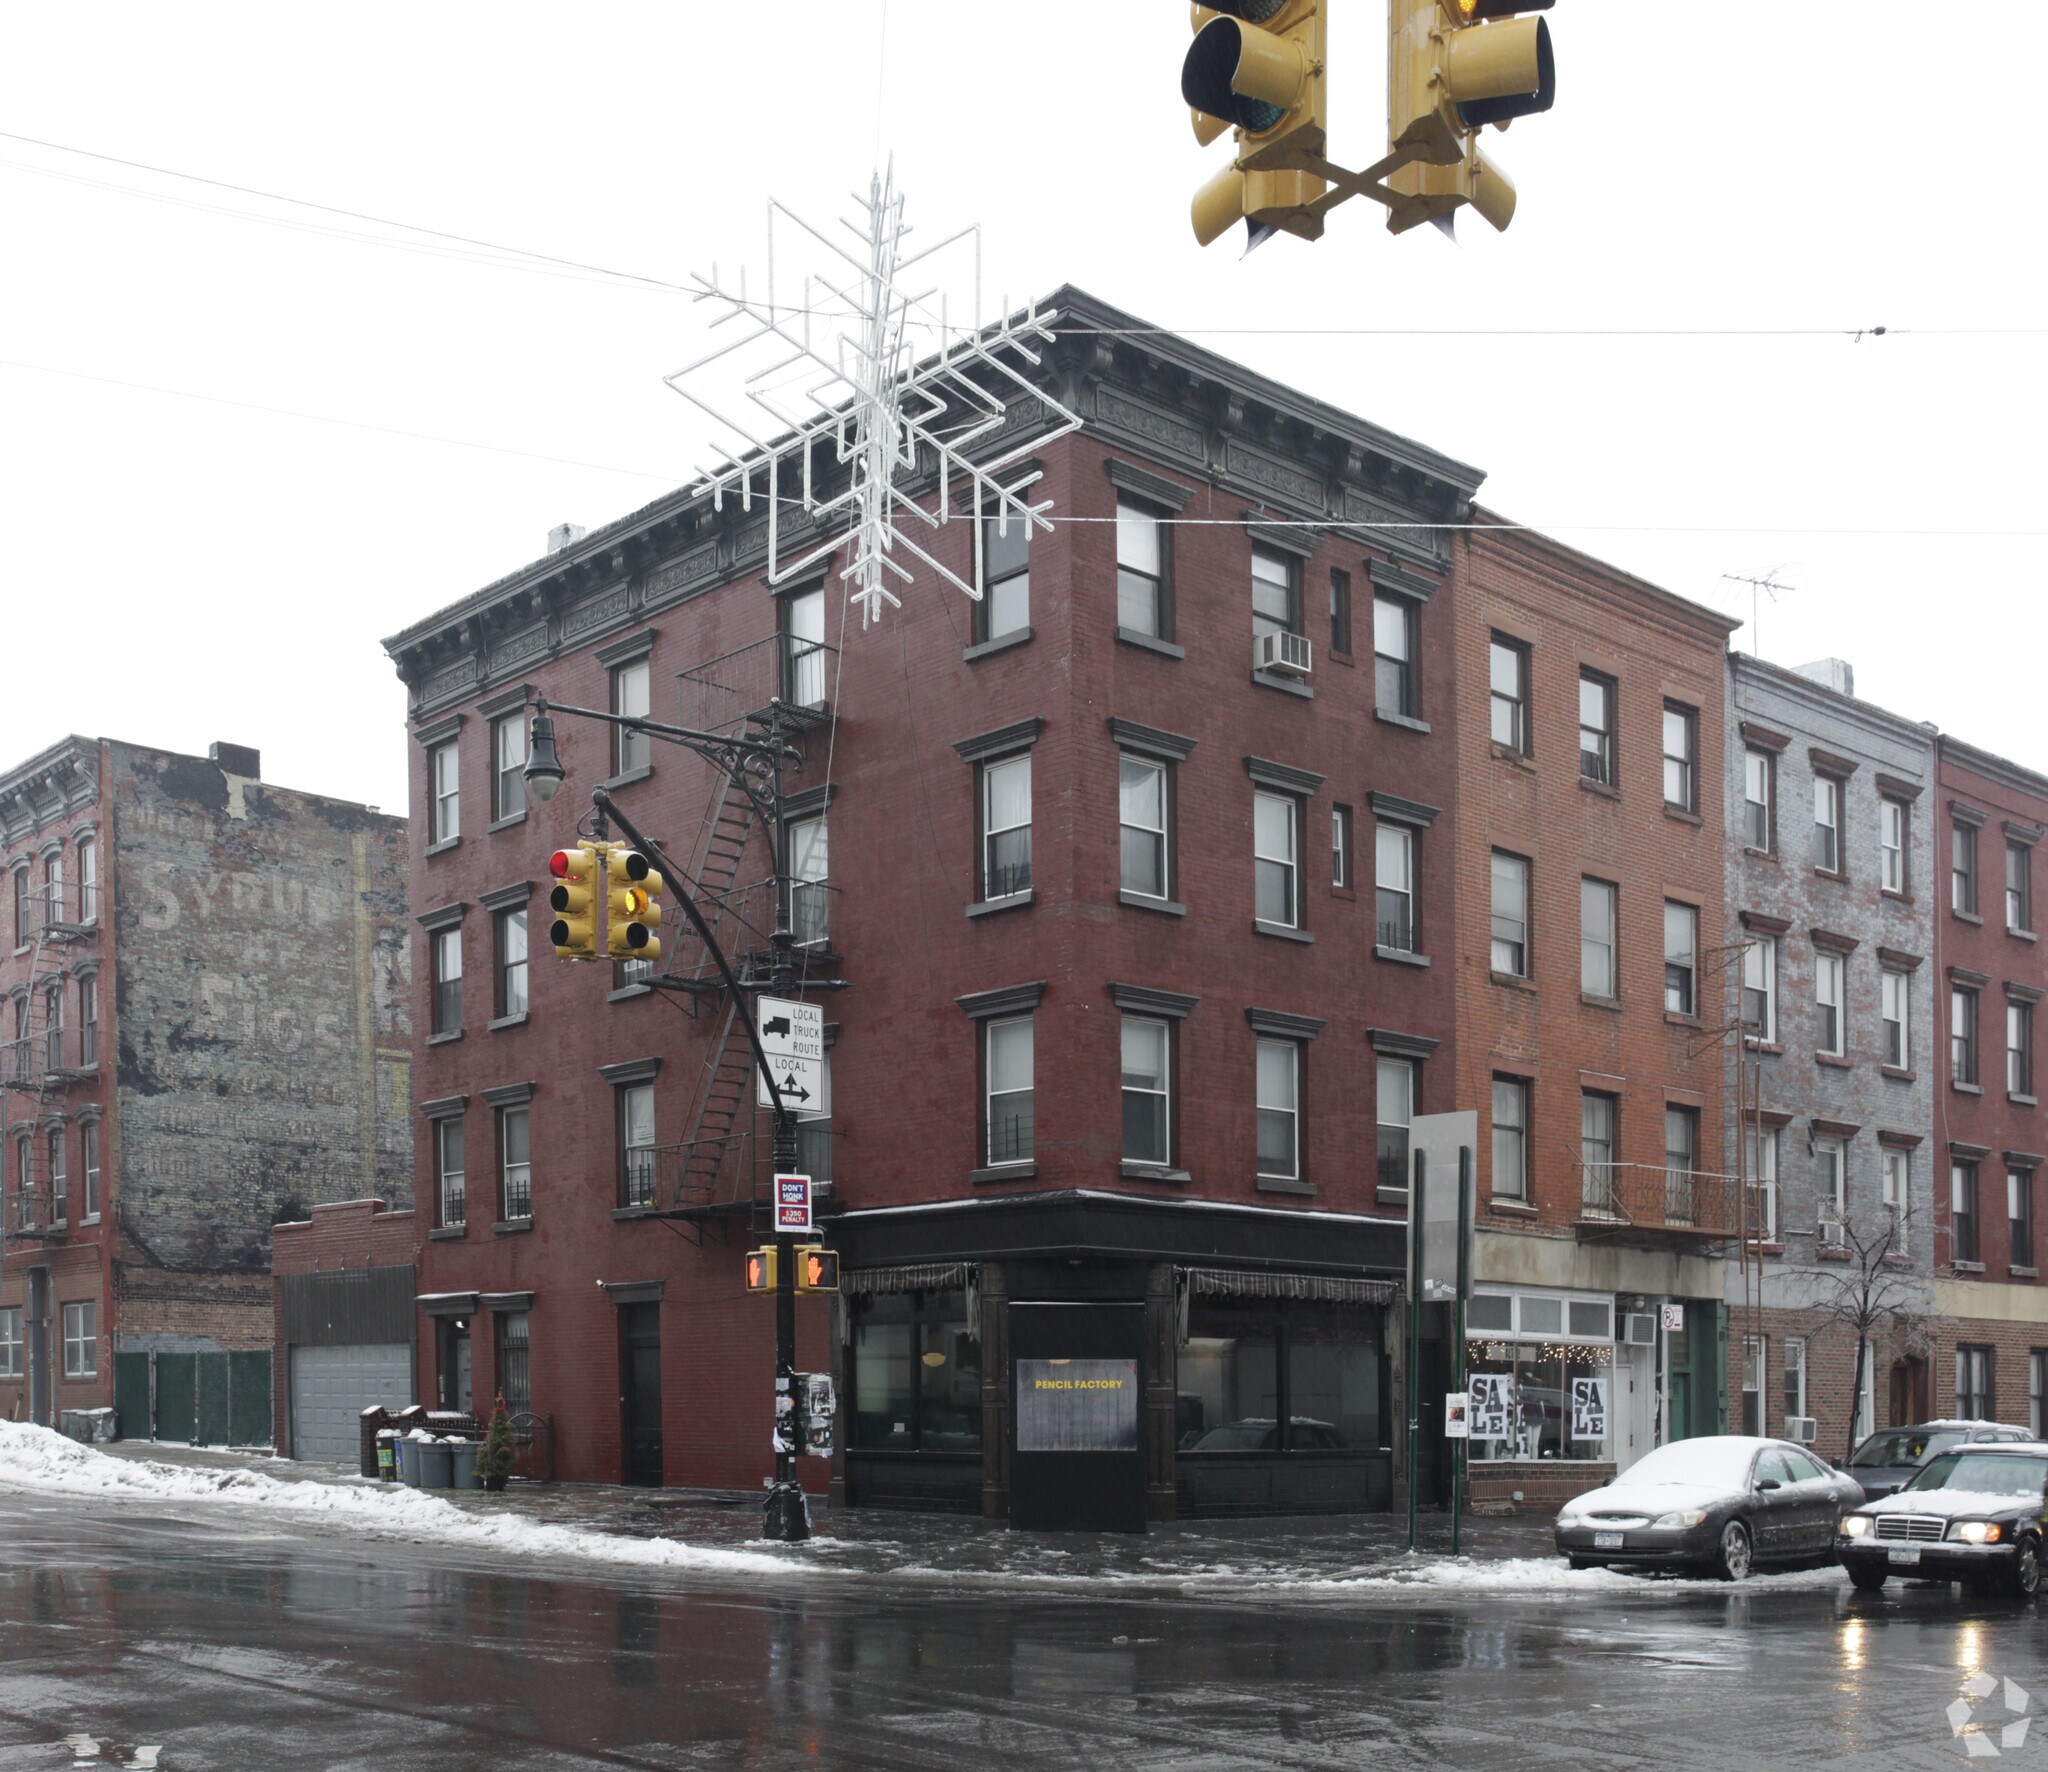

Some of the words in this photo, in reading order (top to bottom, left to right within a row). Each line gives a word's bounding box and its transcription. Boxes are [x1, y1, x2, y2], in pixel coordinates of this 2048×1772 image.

[199, 973, 342, 1053] FIGS
[793, 1008, 819, 1022] LOCAL
[793, 1025, 819, 1038] TRUCK
[793, 1041, 819, 1055] ROUTE
[775, 1058, 807, 1072] LOCAL
[782, 1183, 804, 1192] DON'T
[783, 1192, 804, 1200] HONK
[1035, 1380, 1073, 1389] PENCIL
[1075, 1380, 1123, 1389] FACTORY
